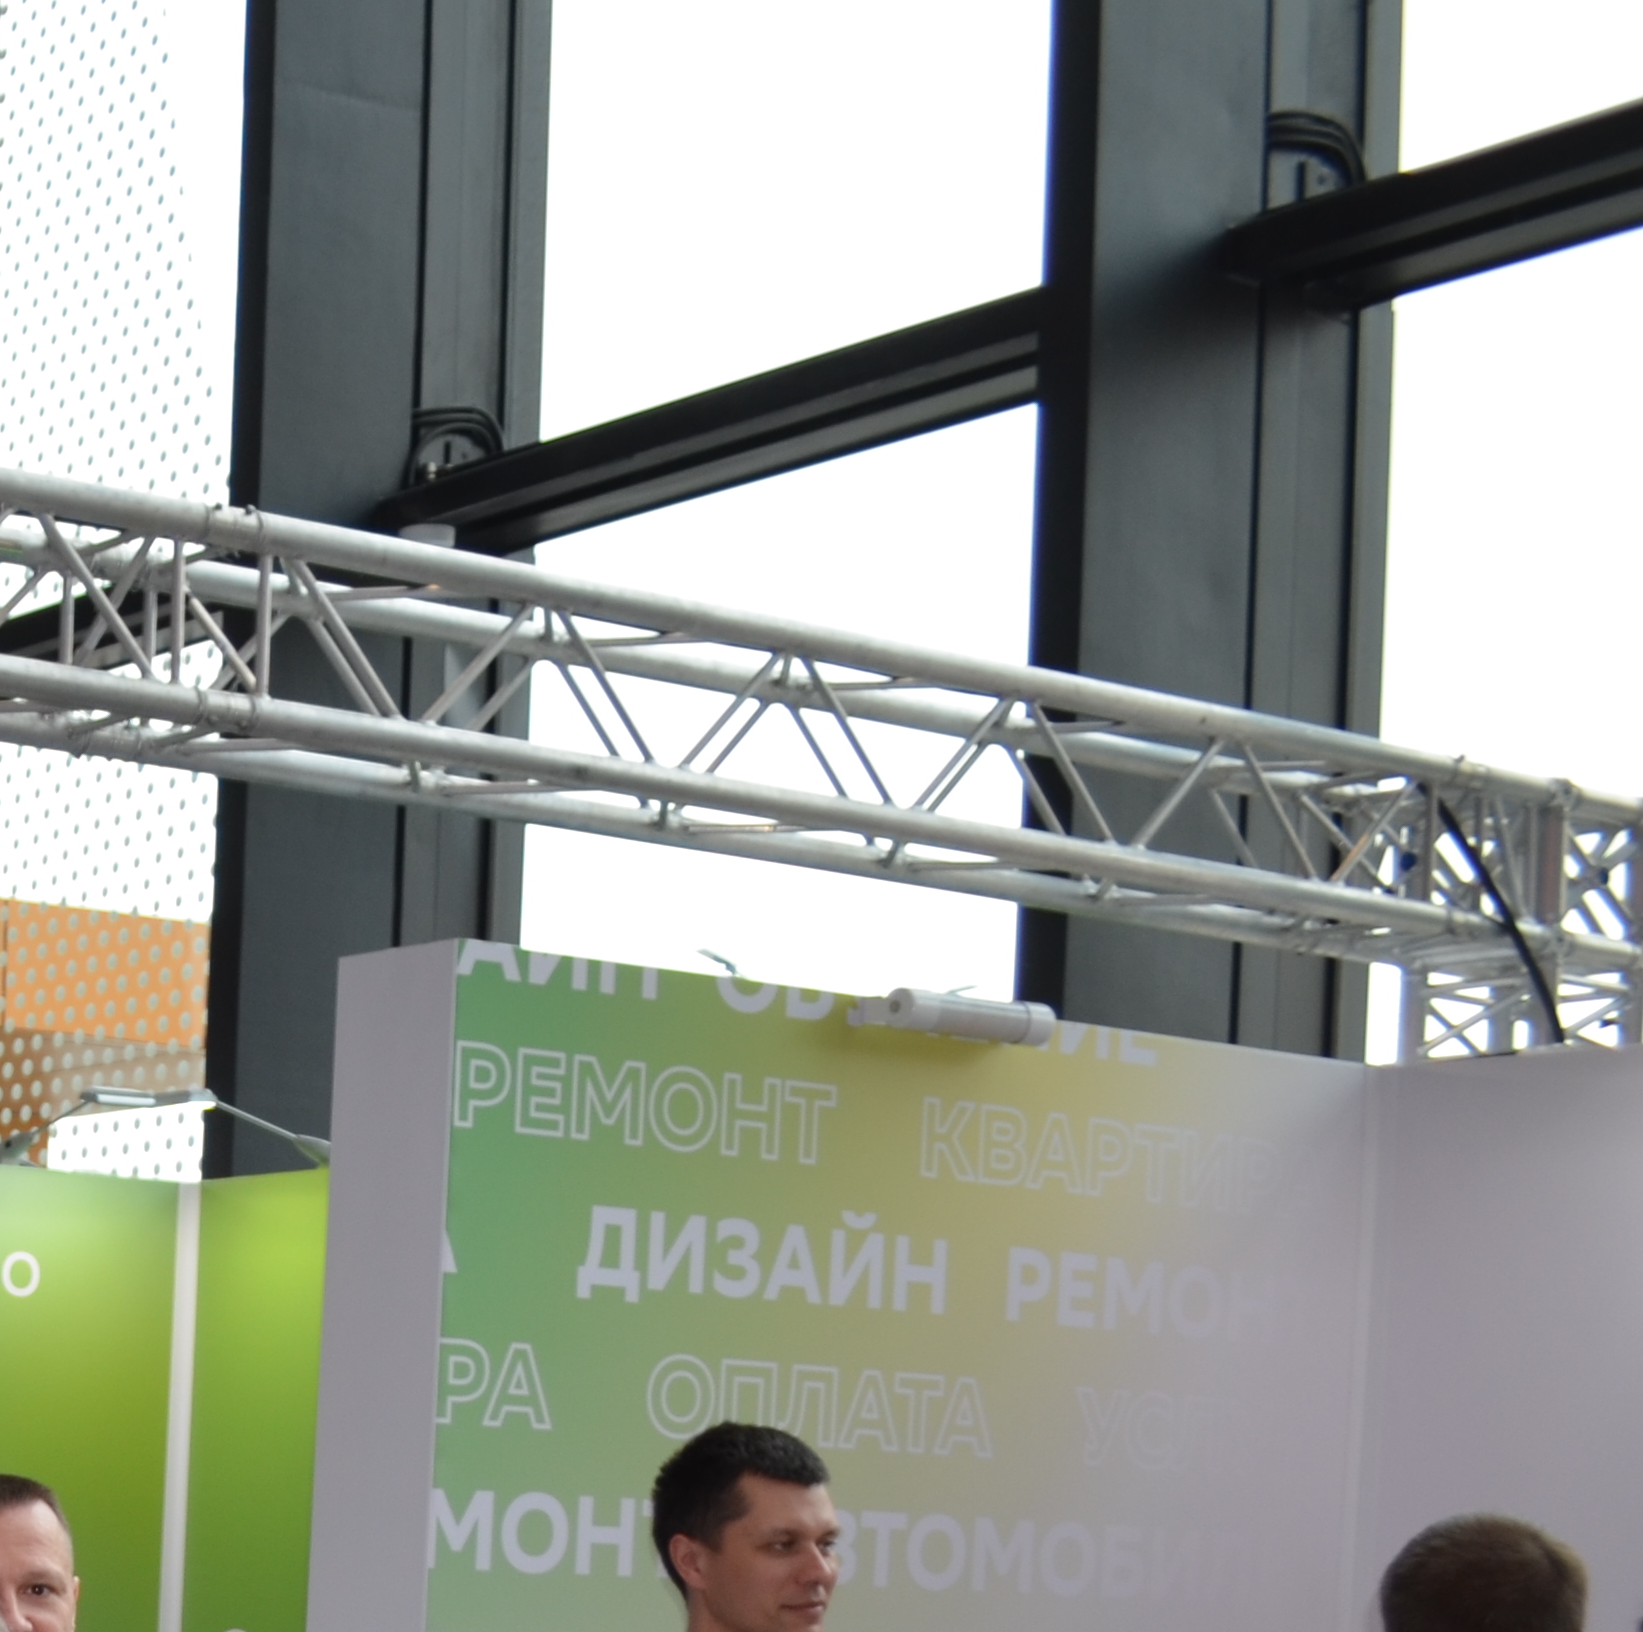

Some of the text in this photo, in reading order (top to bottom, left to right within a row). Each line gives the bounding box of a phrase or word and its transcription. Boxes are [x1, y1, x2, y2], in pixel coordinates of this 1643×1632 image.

[454, 1040, 837, 1165] РЕМОНТ
[577, 1205, 948, 1315] ДИЗАЙН
[1005, 1248, 1285, 1342] РЕМОН
[647, 1354, 993, 1458] ОПЛАТА
